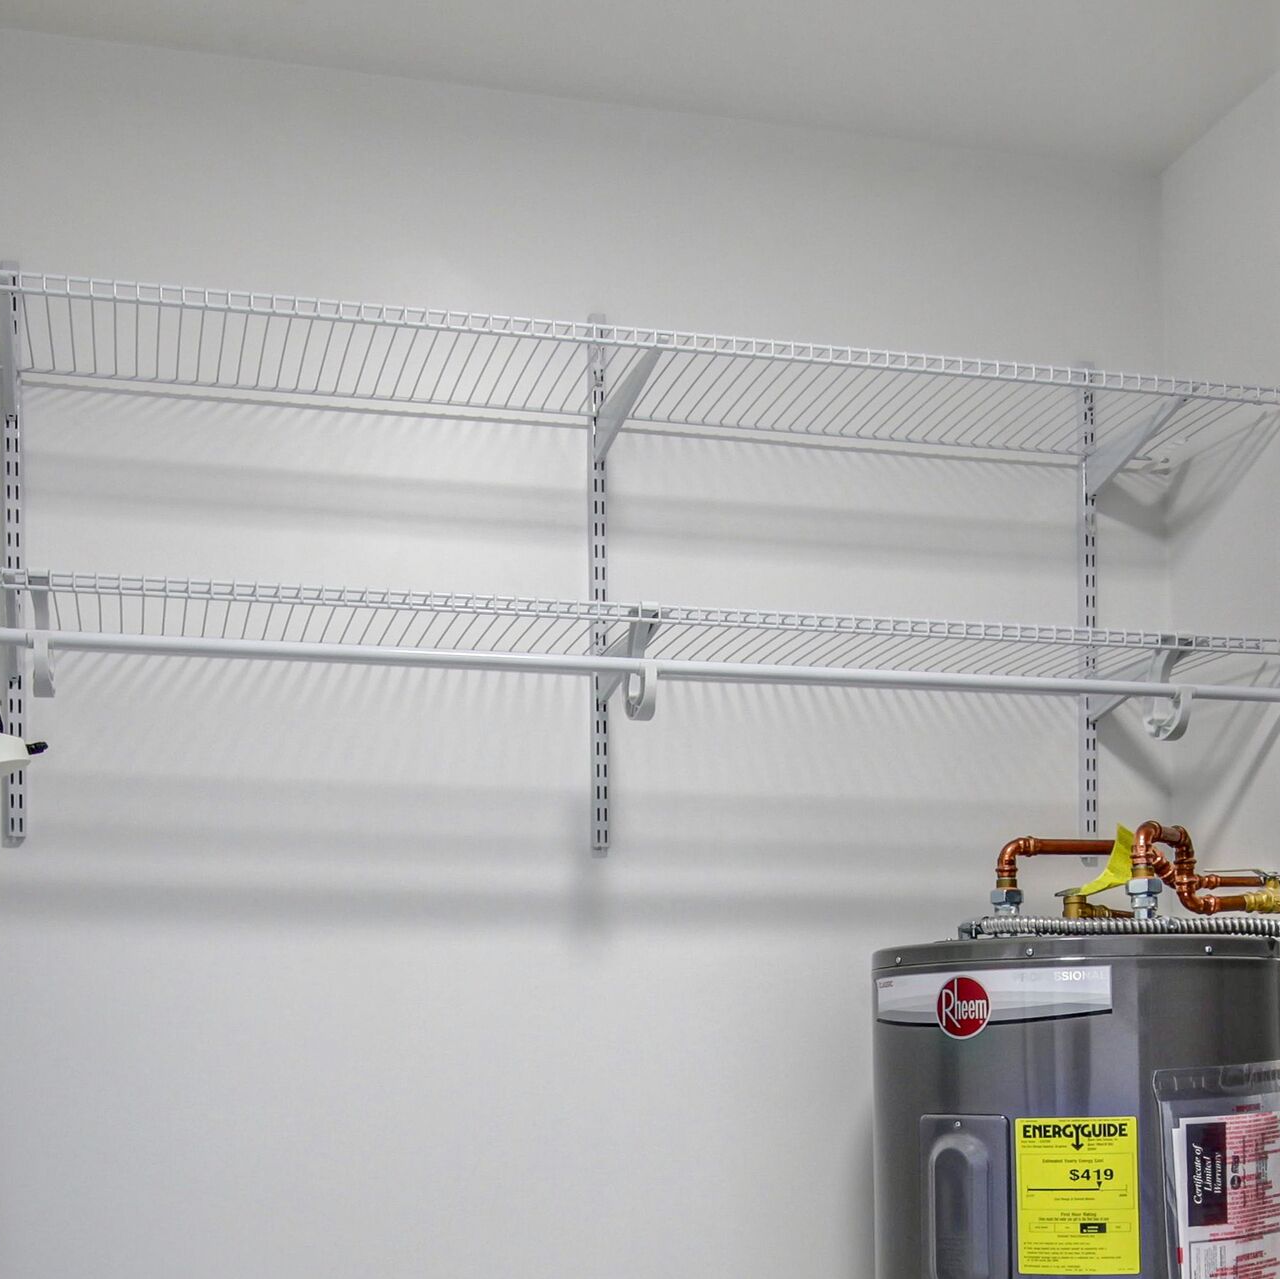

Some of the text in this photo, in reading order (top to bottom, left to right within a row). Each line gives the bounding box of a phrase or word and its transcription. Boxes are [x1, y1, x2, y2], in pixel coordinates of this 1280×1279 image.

[941, 978, 987, 1028] Rheem
[1022, 1123, 1128, 1139] ENERGYGUIDE
[1069, 1168, 1114, 1182] $419
[1192, 1143, 1204, 1205] Certificate of
[1203, 1156, 1212, 1192] Limited
[1213, 1152, 1223, 1194] Warranty
